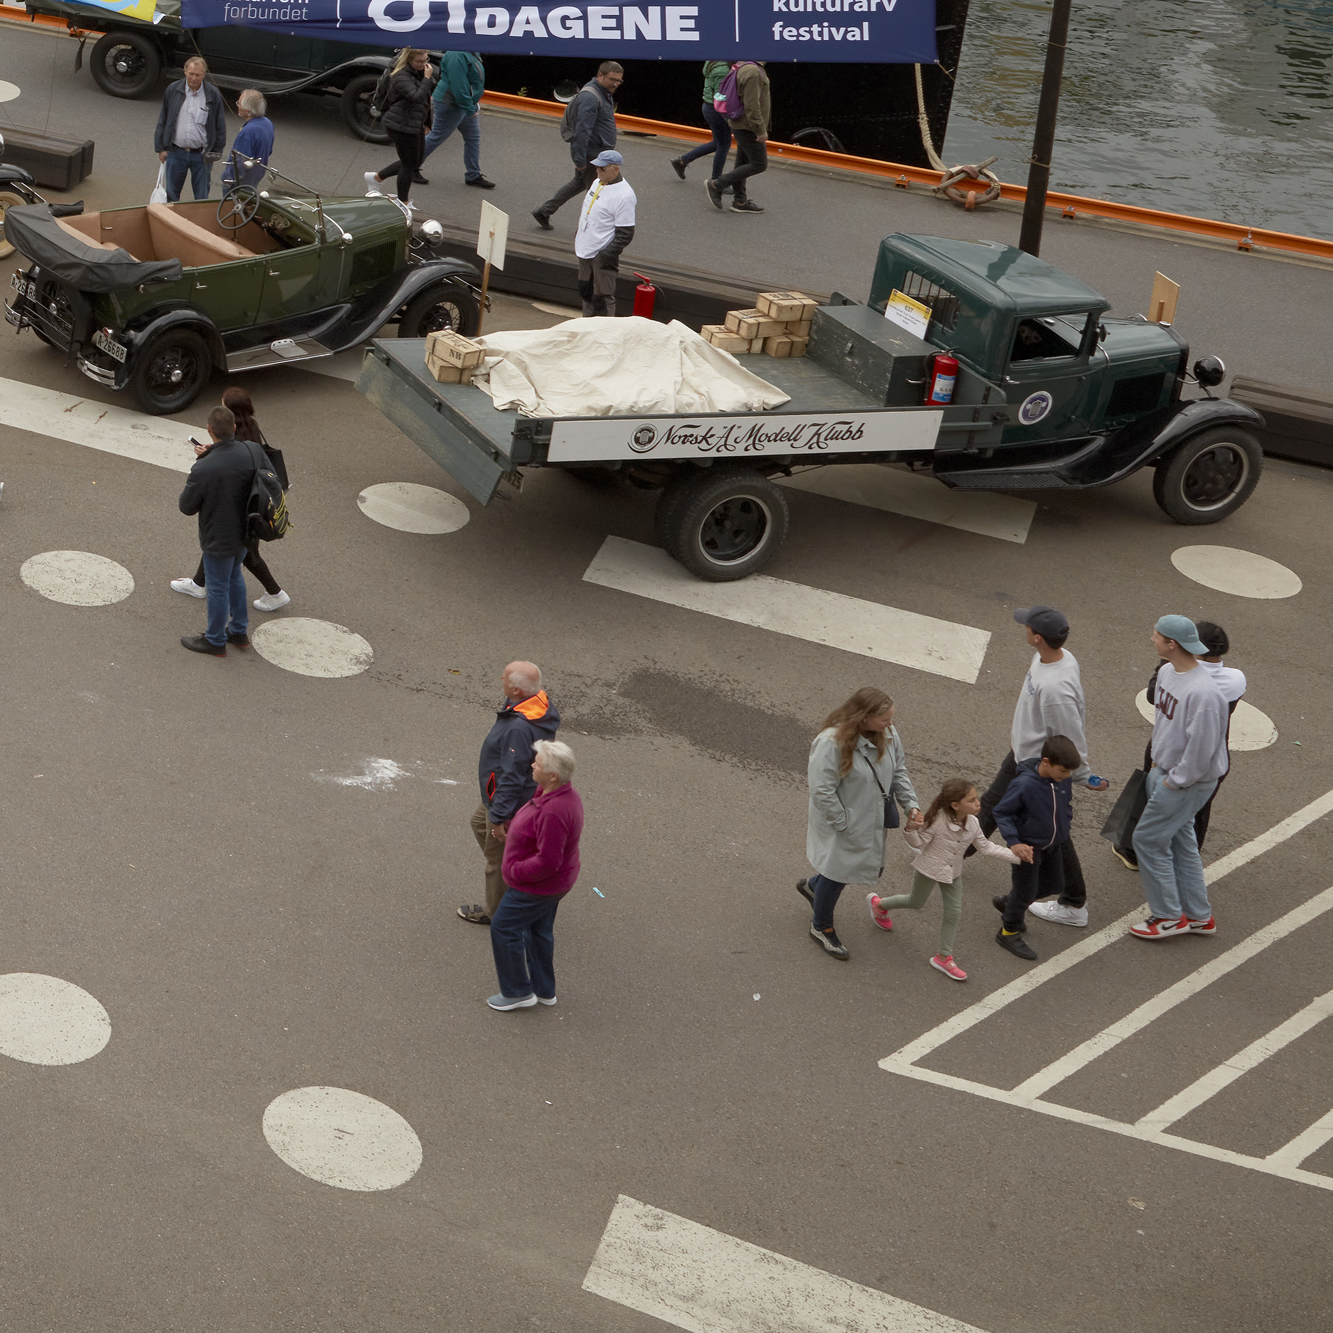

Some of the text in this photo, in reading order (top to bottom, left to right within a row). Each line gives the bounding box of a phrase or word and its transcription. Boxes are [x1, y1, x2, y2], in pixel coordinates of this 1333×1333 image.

[223, 2, 309, 22] forbundet
[473, 5, 700, 41] DAGENE
[771, 21, 870, 41] festival
[97, 334, 126, 360] A-26688
[449, 348, 462, 361] NB
[655, 423, 717, 453] Norsk
[737, 422, 807, 452] Modell
[800, 420, 866, 450] Klubb
